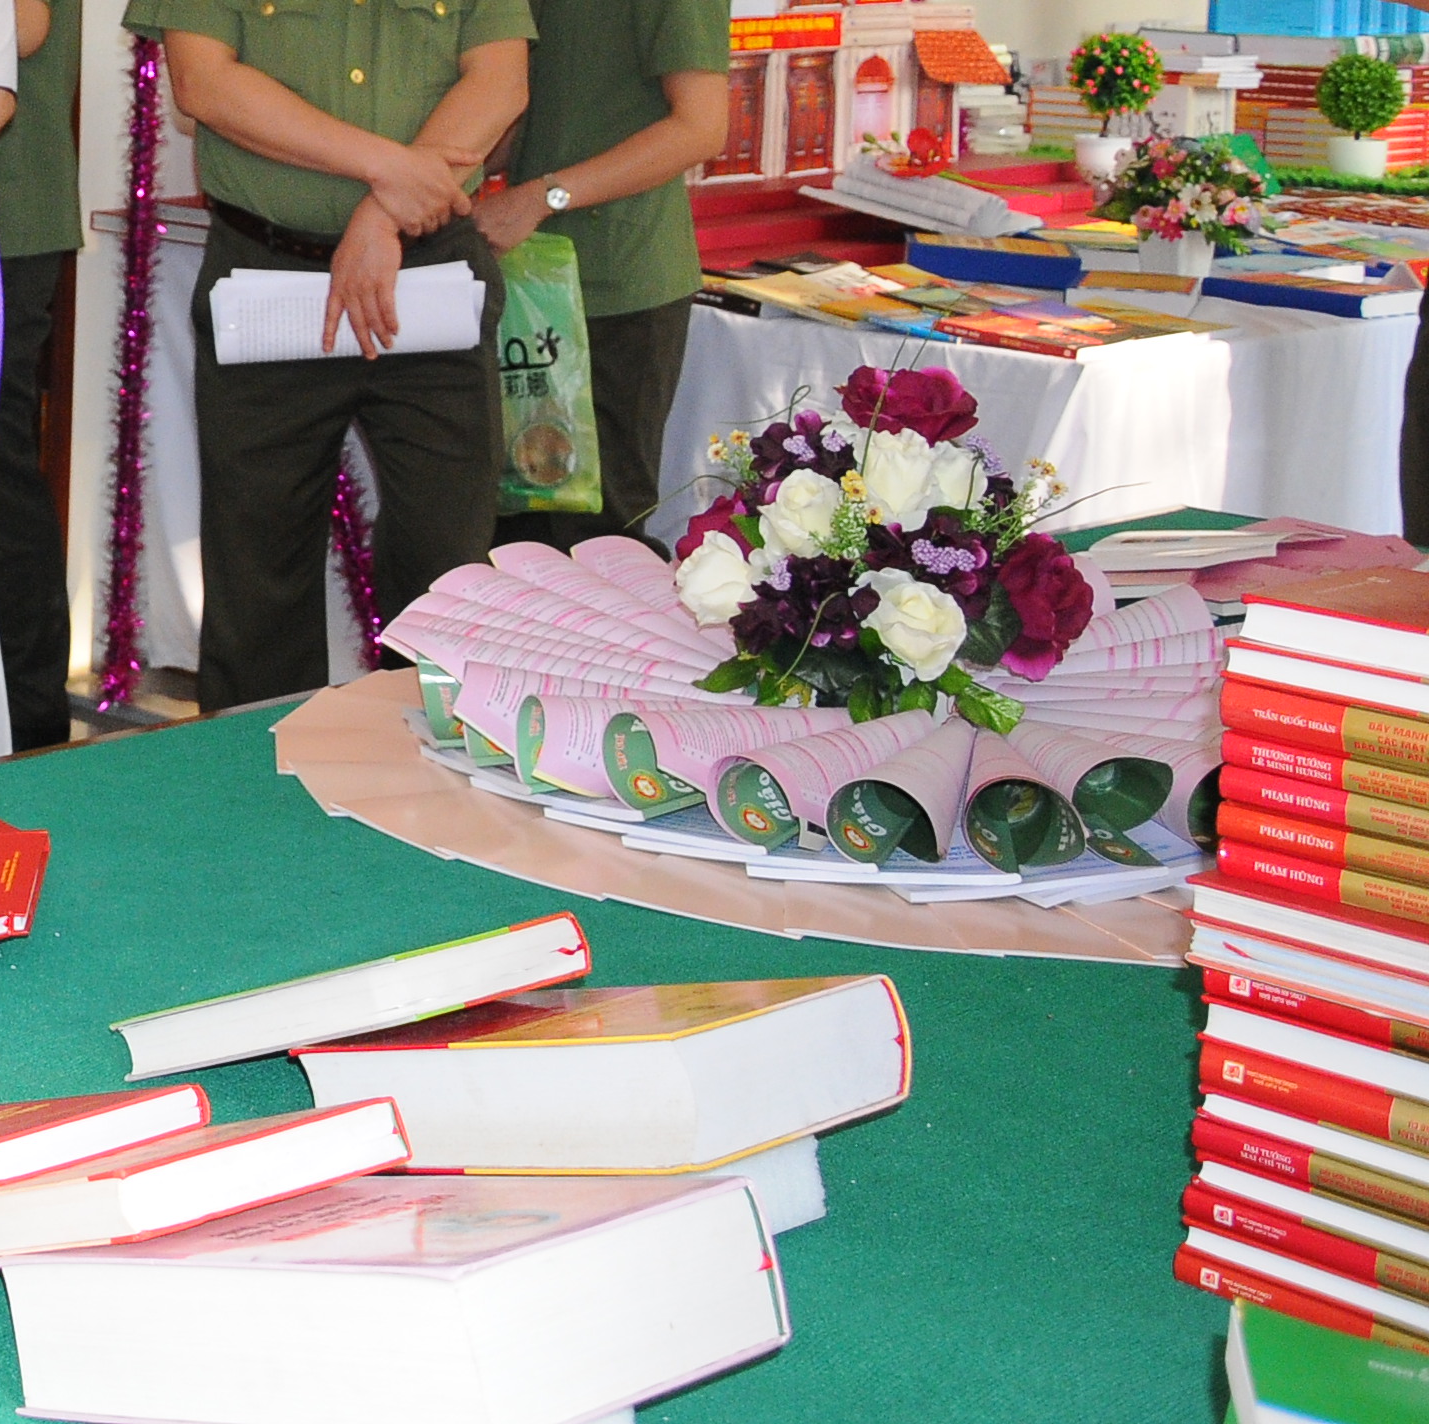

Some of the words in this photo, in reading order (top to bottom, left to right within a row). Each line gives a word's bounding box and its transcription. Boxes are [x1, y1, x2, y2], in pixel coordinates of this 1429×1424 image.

[1280, 712, 1307, 728] QUỐC
[1267, 761, 1292, 773] MINH
[758, 771, 794, 821] Giáo
[1261, 789, 1293, 803] PHẠM
[1259, 825, 1295, 842] PHẠM
[1254, 861, 1287, 877] PHẠM
